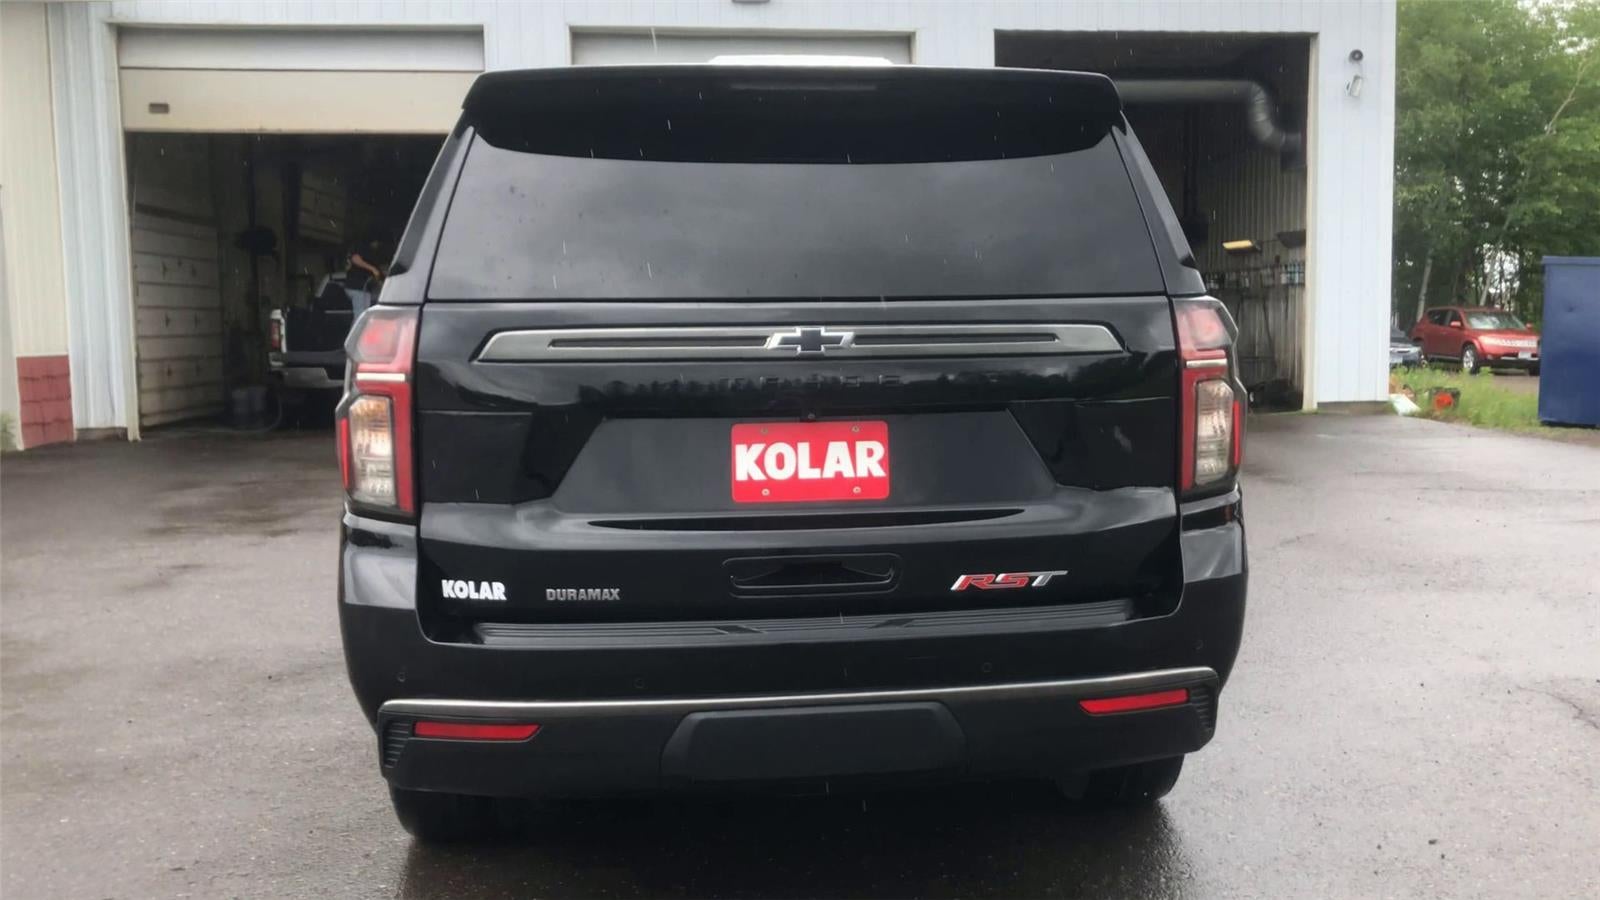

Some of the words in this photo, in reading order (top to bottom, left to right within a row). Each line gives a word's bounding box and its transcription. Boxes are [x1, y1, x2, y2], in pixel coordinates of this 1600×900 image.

[734, 440, 886, 481] KOLAR
[441, 580, 507, 600] KOLAR
[950, 570, 1068, 591] RST
[546, 588, 620, 601] DURAMAX
